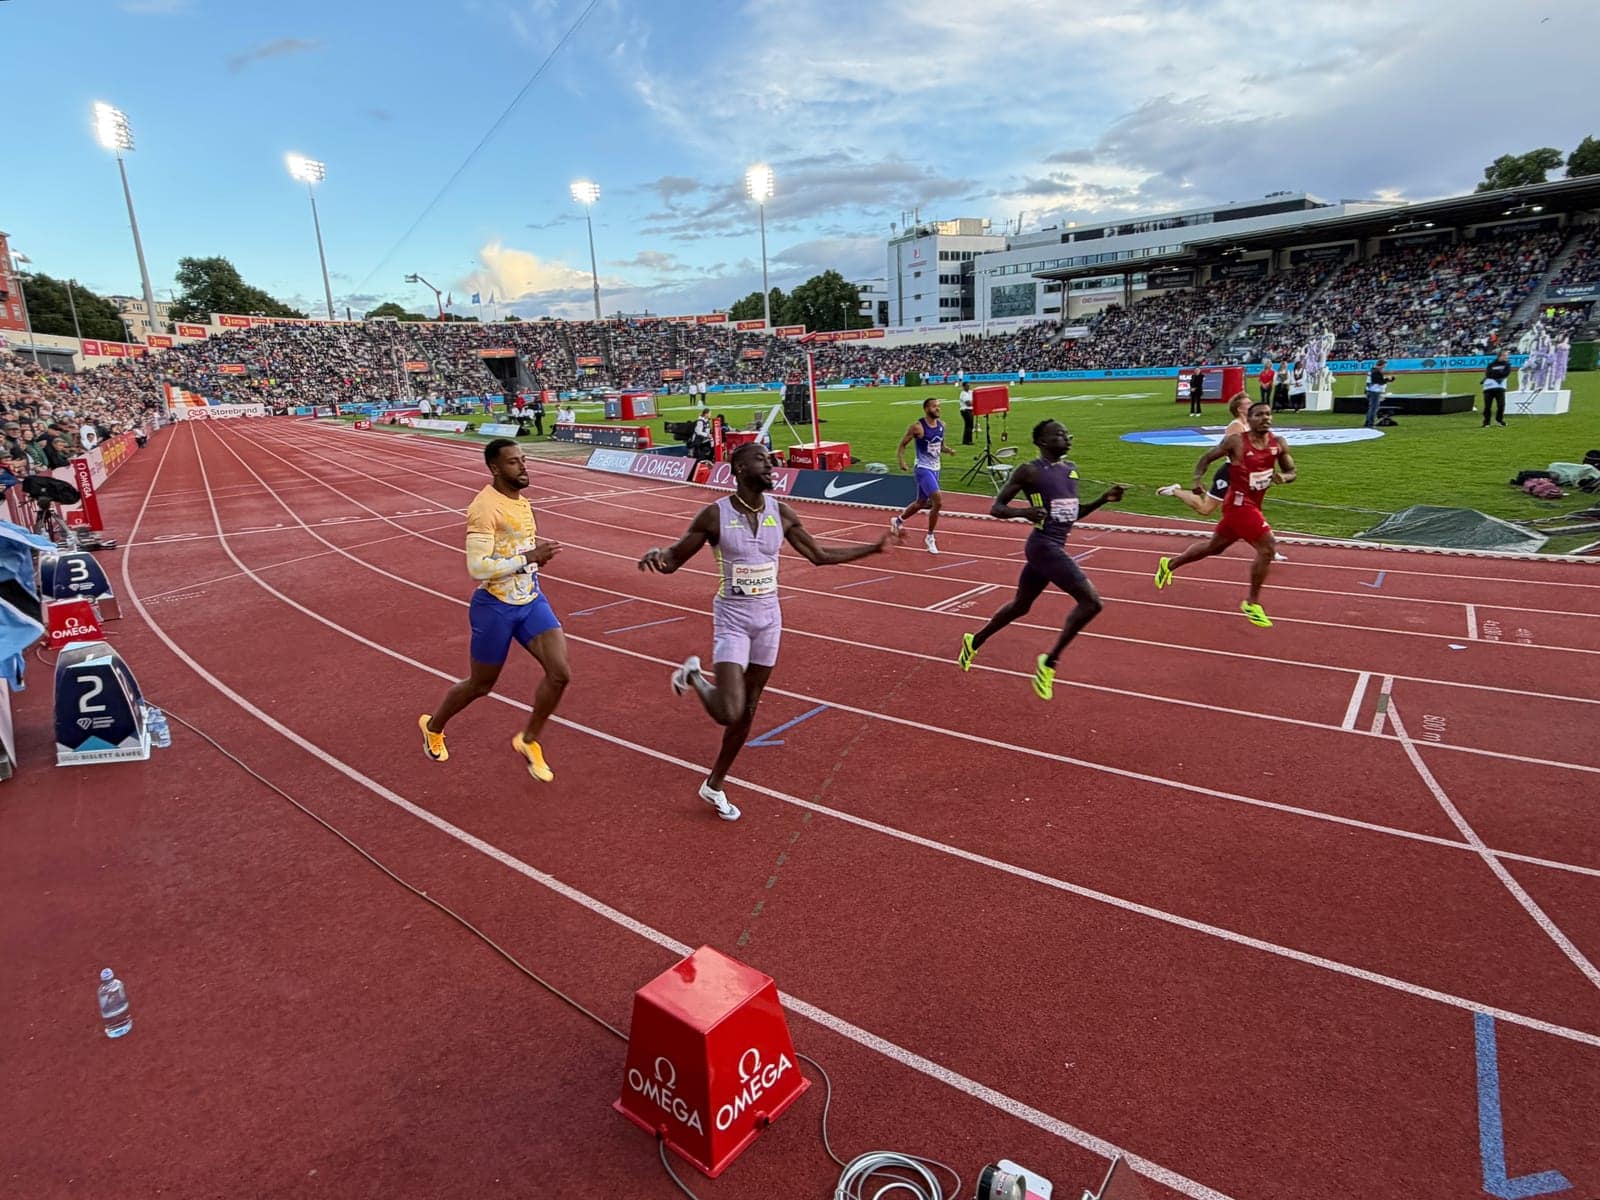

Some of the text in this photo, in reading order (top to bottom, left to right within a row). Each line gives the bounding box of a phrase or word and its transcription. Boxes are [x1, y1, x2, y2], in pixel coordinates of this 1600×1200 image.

[1440, 358, 1477, 368] WORLD
[210, 406, 259, 415] Storebrand
[647, 459, 686, 478] OMEGA
[79, 471, 93, 499] OMEGA
[67, 559, 89, 582] 3
[52, 624, 97, 639] OMEGA
[77, 675, 106, 713] 2
[1423, 714, 1446, 742] 800 m
[628, 1068, 704, 1136] OMEGA
[715, 1053, 792, 1131] OMEGA
